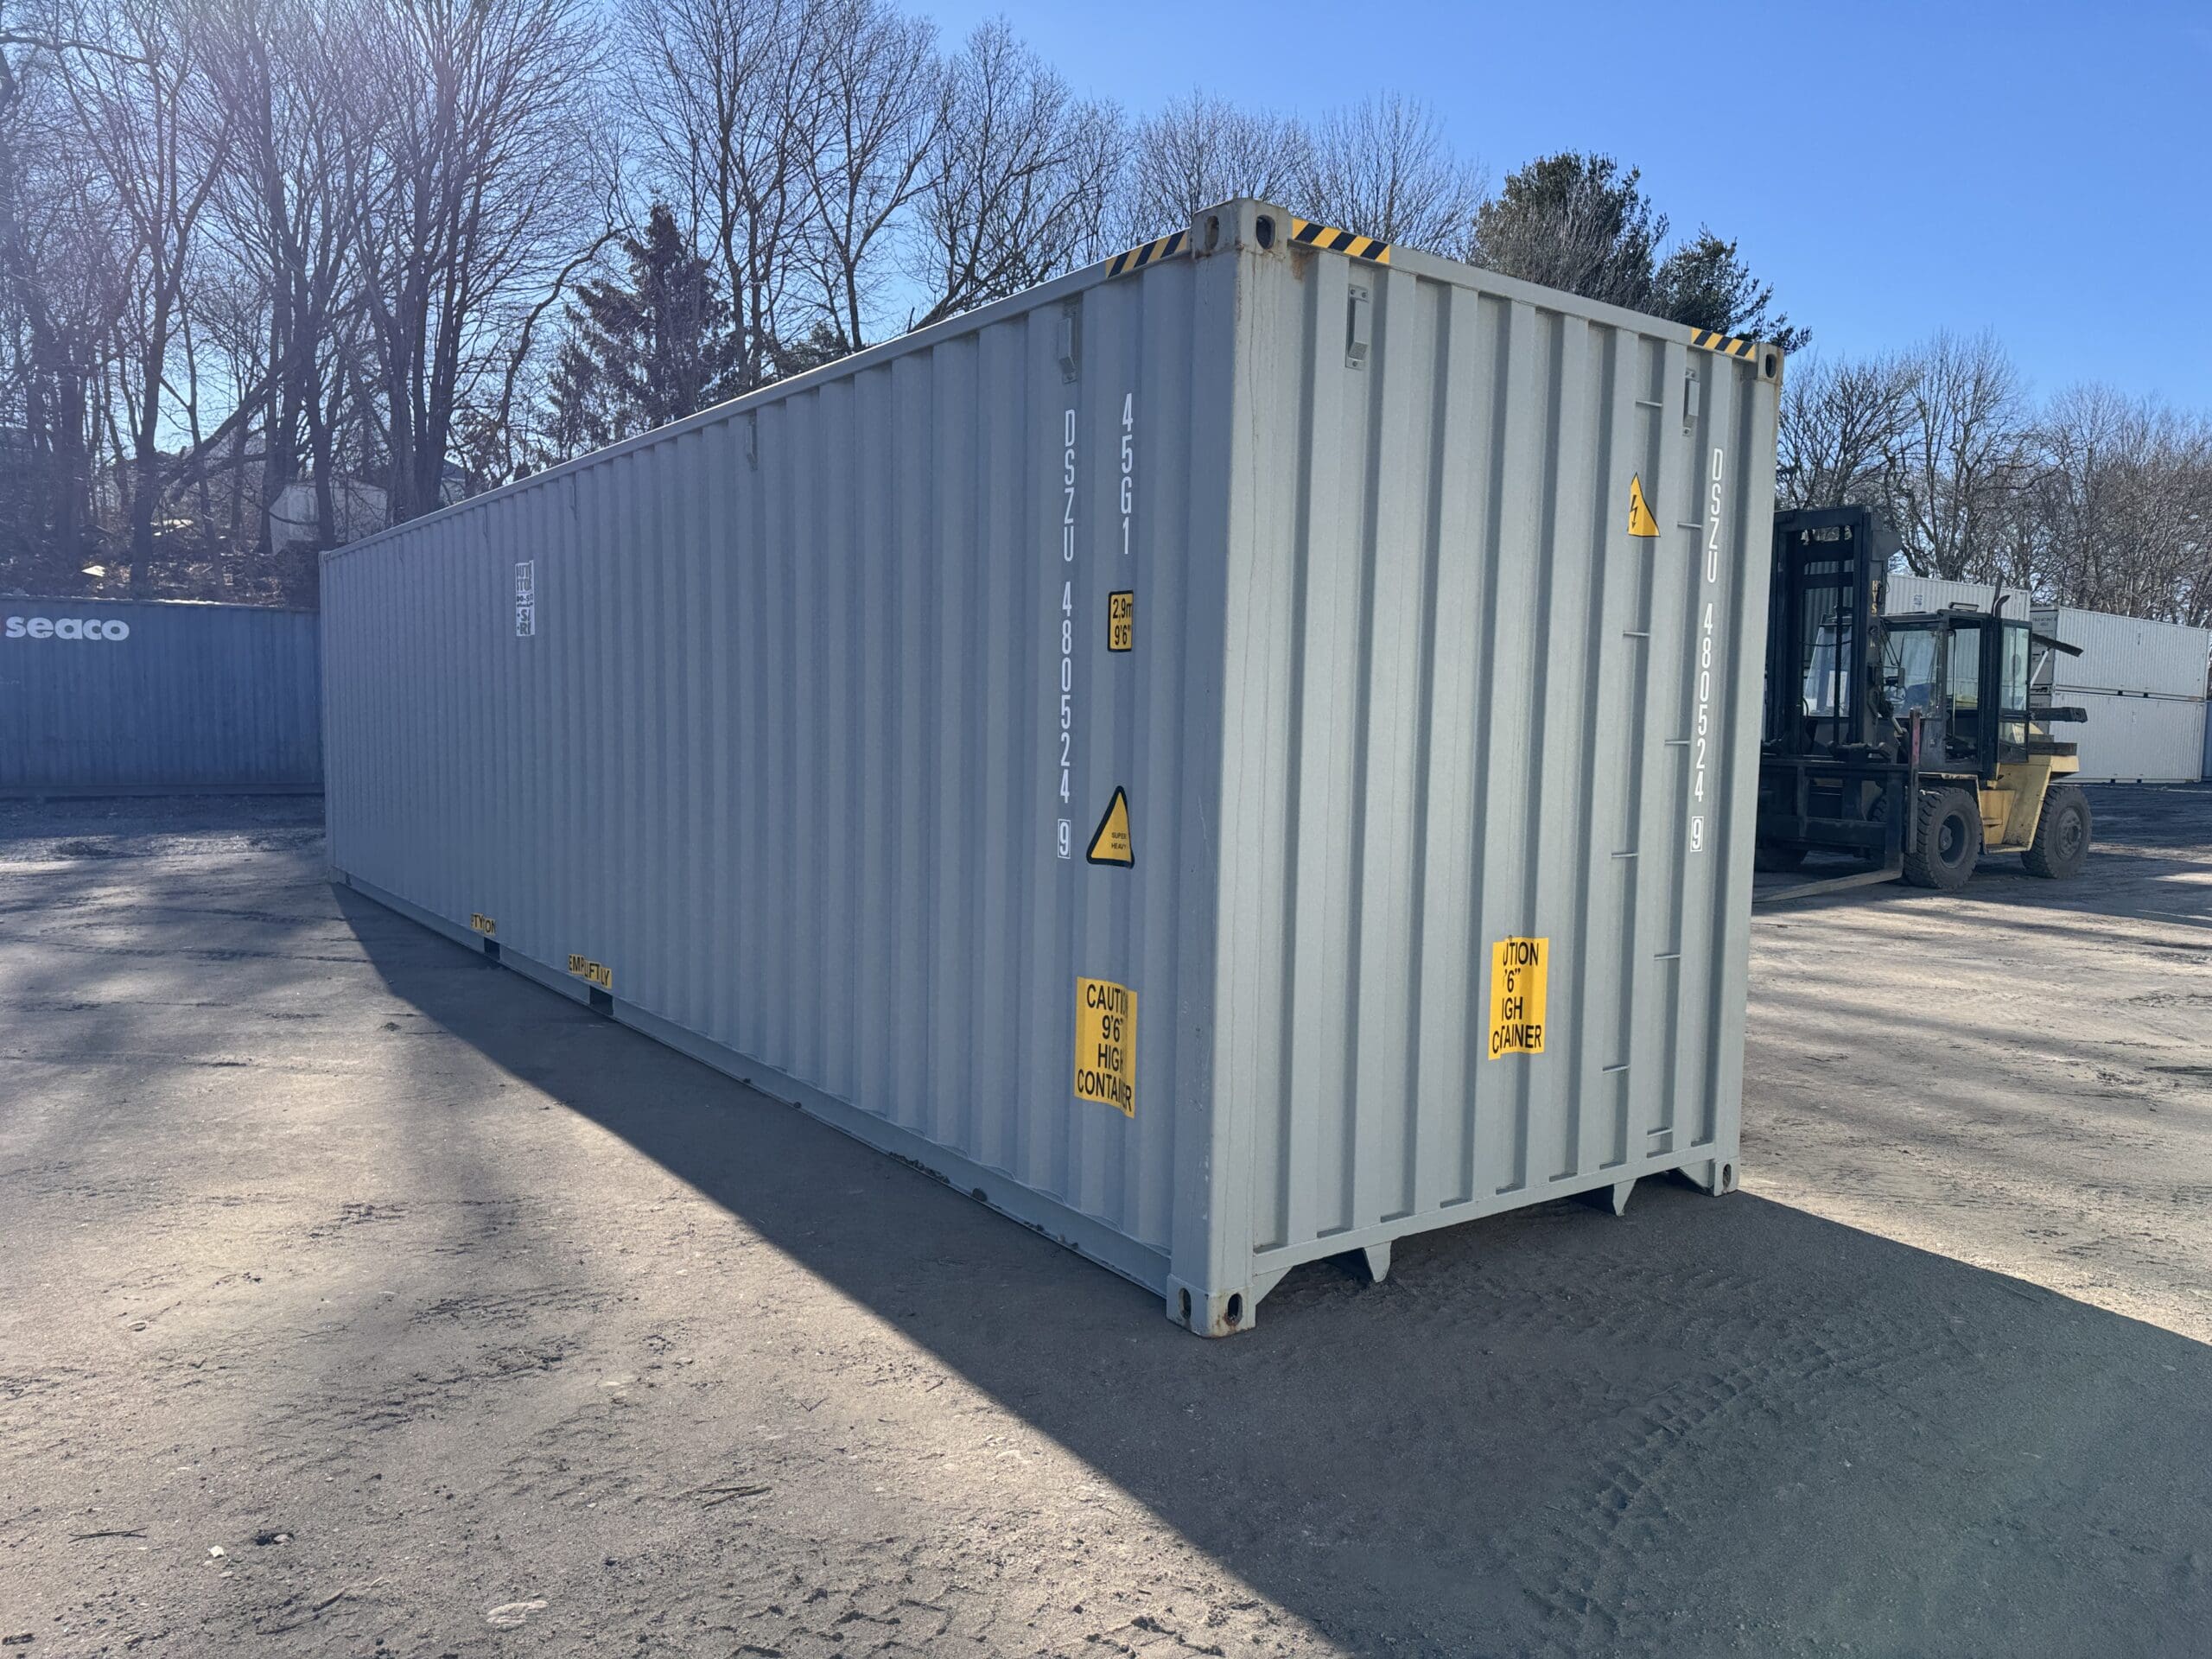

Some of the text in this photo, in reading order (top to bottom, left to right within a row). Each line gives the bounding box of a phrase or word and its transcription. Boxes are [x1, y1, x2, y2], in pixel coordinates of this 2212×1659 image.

[1121, 393, 1134, 555] 45G1
[5, 616, 130, 641] seaco
[1058, 409, 1076, 856] DSZU 480524 9
[1691, 448, 1724, 850] DSZU 480524 9
[1502, 996, 1523, 1021] IGH
